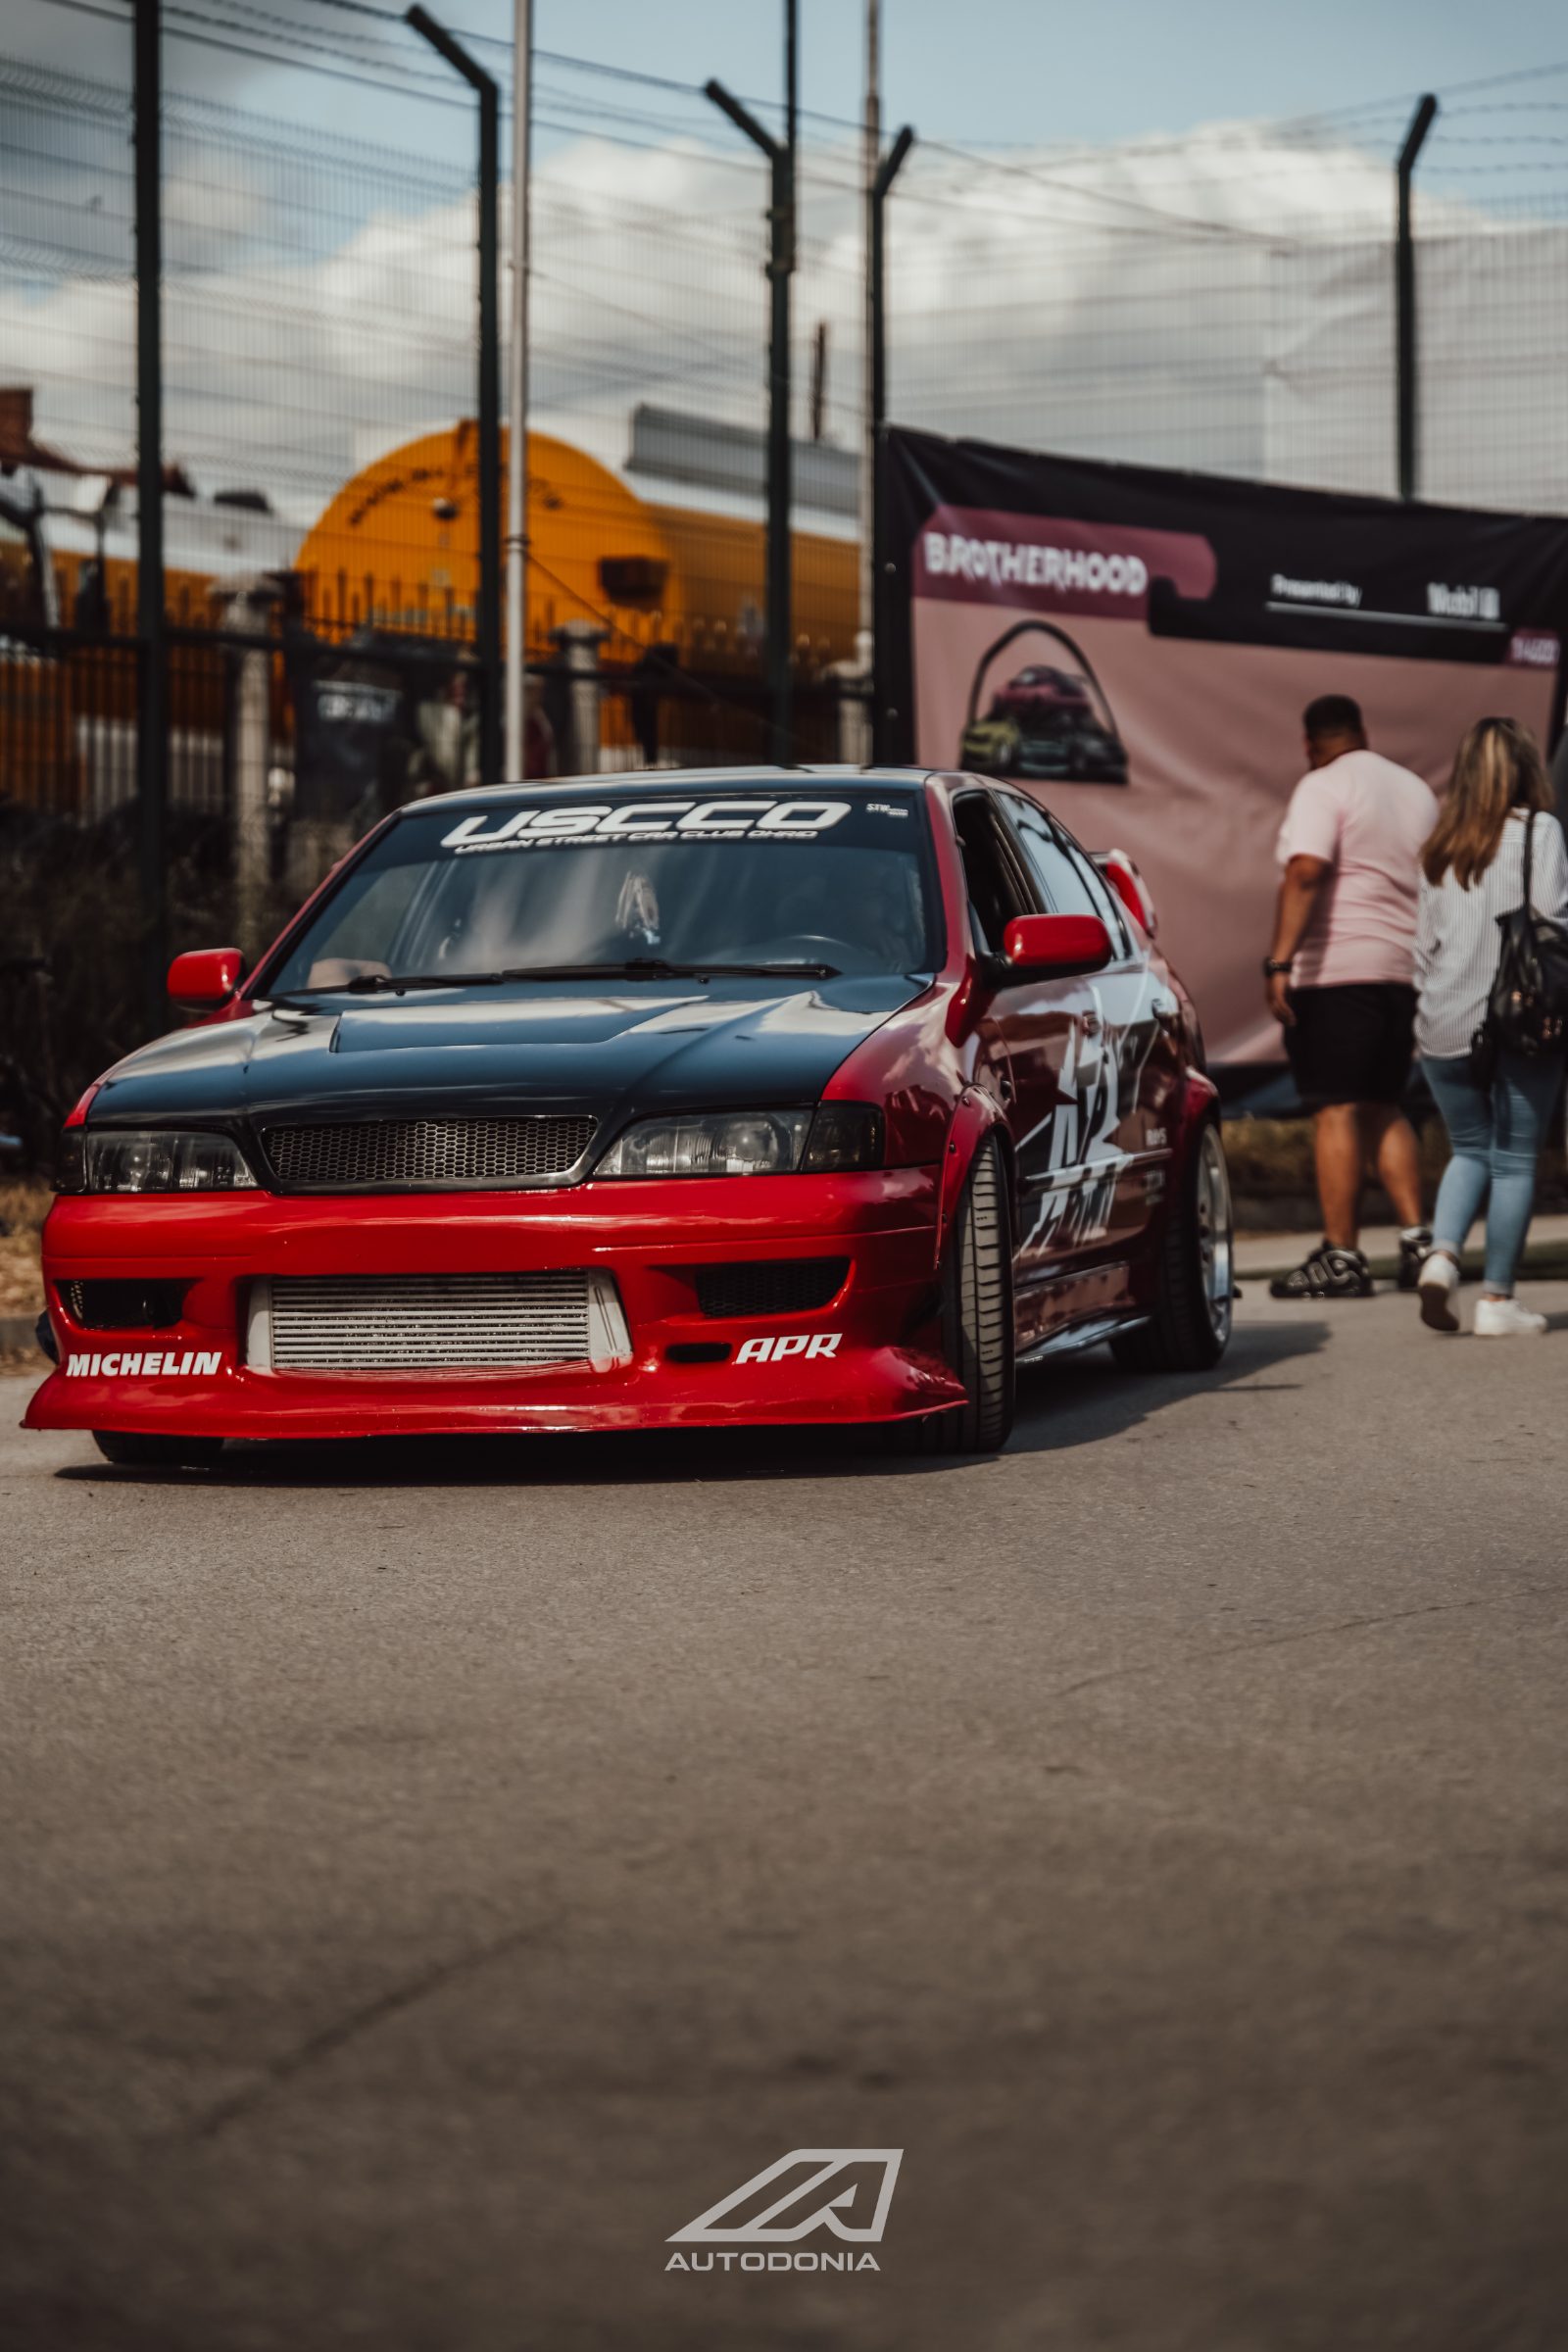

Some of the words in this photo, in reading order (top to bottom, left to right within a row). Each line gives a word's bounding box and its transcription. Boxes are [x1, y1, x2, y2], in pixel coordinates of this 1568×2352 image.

[924, 531, 1149, 596] BROTHERHOOD
[441, 801, 852, 848] USCCO
[454, 838, 534, 855] URBAN
[535, 833, 628, 847] STREET
[628, 831, 679, 841] CAR
[680, 830, 746, 840] CLUB
[747, 829, 819, 840] OHRID
[735, 1333, 843, 1364] APR
[66, 1352, 222, 1377] MICHELIN
